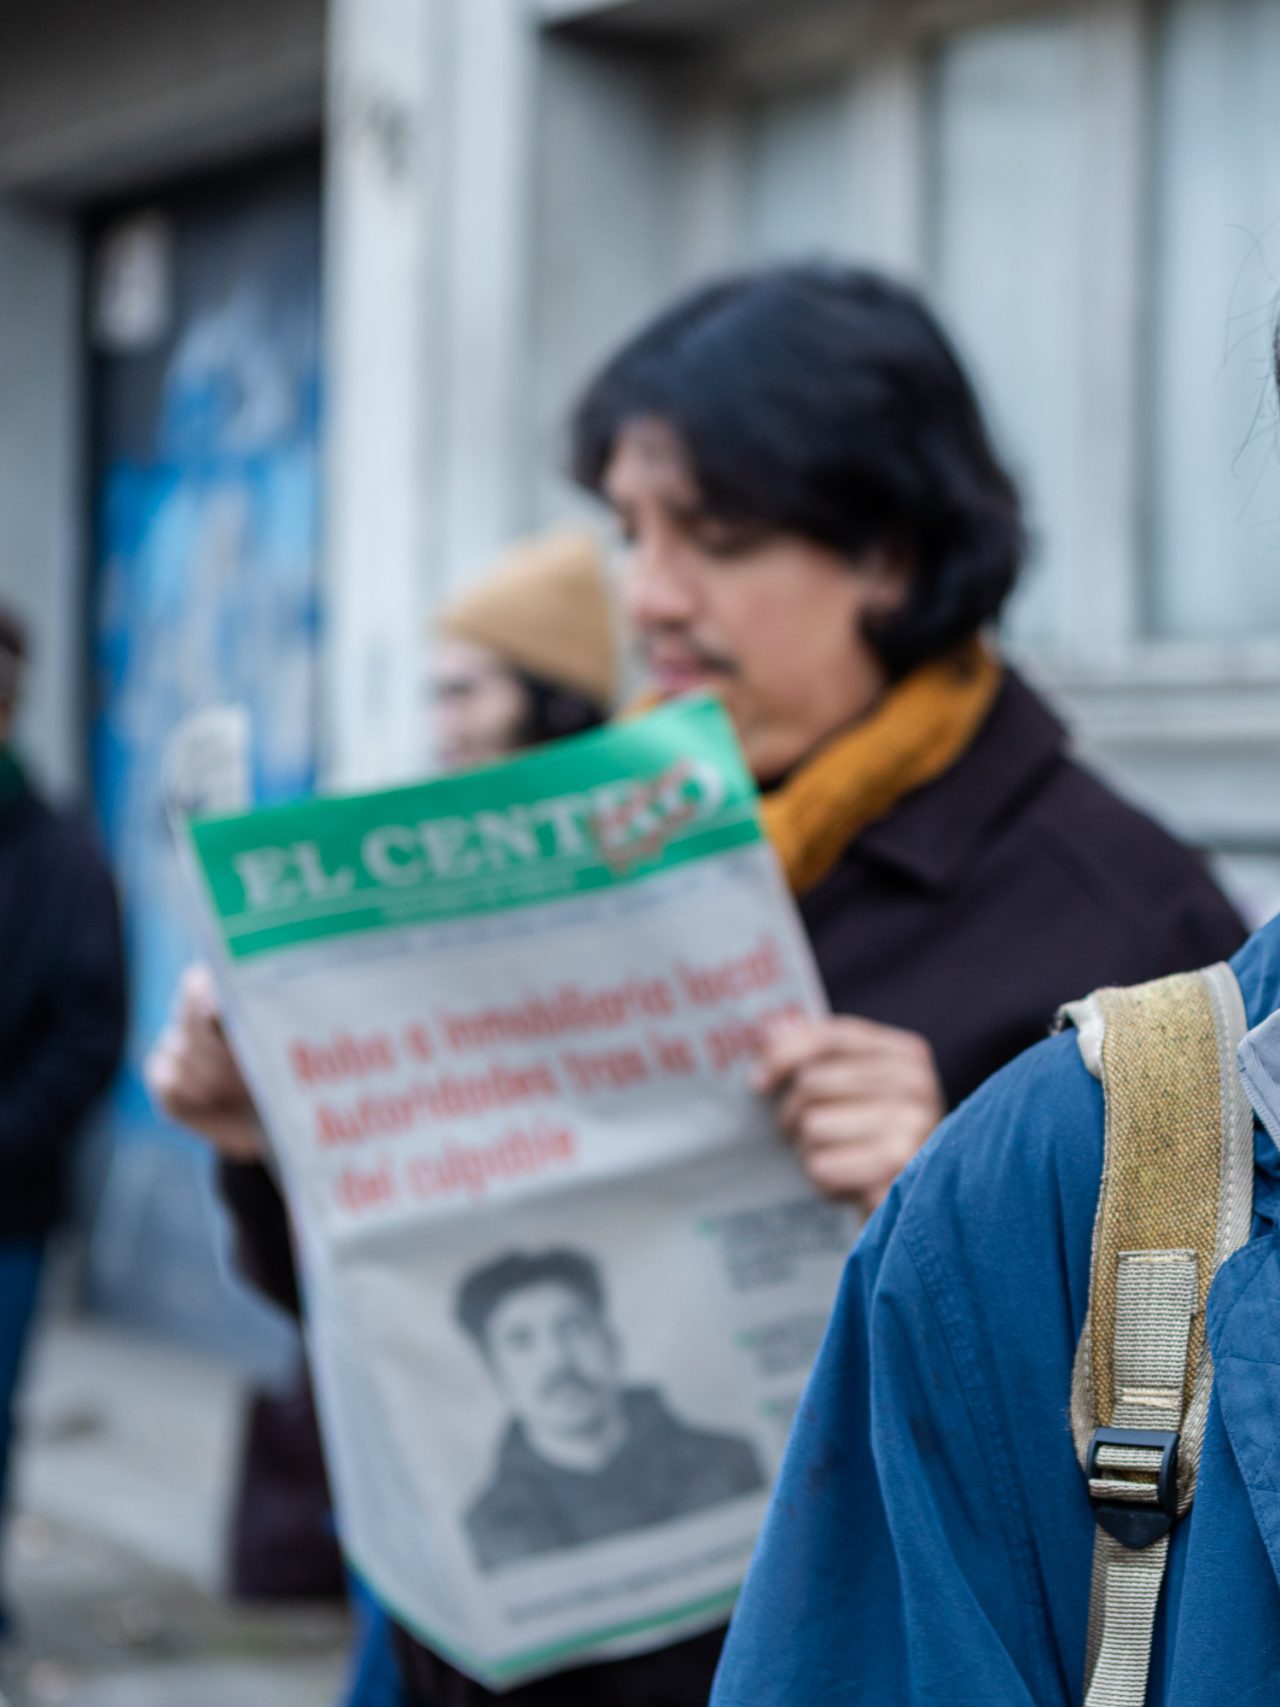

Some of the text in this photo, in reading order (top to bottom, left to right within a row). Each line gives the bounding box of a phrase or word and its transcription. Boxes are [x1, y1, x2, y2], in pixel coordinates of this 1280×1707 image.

[238, 840, 354, 906] EL
[361, 761, 724, 886] CENTRO
[290, 933, 782, 1086] Robo a inmobiliaria local
[317, 1066, 556, 1146] Autoridades
[562, 1046, 650, 1094] tras
[648, 1030, 698, 1076] la
[336, 1118, 574, 1212] del culpable
